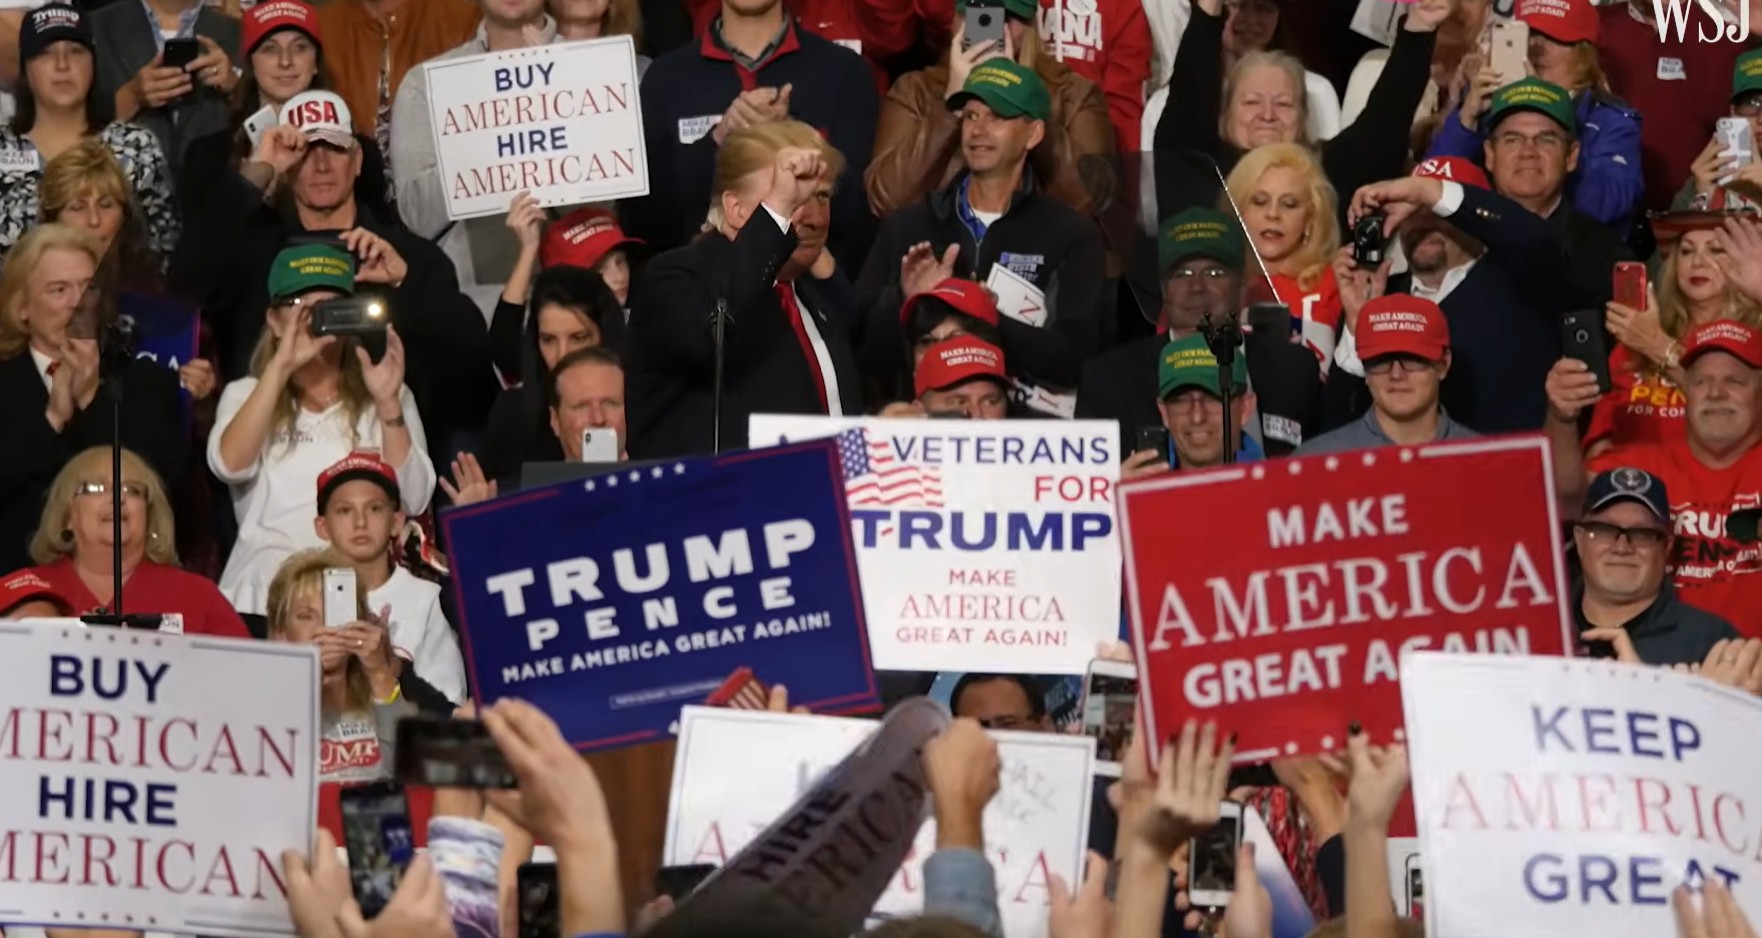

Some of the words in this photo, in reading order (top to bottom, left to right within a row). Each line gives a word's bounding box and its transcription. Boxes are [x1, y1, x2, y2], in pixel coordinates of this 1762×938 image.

[33, 9, 79, 24] Trump
[495, 62, 555, 92] BUY
[289, 100, 340, 129] USA
[442, 83, 628, 136] AMERICAN
[497, 126, 568, 157] HIRE
[453, 148, 636, 200] AMERICAN
[892, 436, 1110, 464] VETERANS
[1034, 476, 1111, 501] FOR
[851, 510, 1112, 551] TRUMP
[1267, 494, 1409, 548] MAKE
[485, 518, 816, 618] TRUMP
[949, 569, 1017, 587] MAKE
[526, 577, 795, 651] PENCE
[900, 594, 1066, 622] AMERICA
[1149, 542, 1554, 651] AMERICA
[502, 656, 564, 685] MAKE
[570, 639, 670, 672] AMERICA
[675, 625, 747, 653] GREAT
[753, 611, 832, 640] AGAIN!
[896, 627, 975, 645] GREAT
[984, 628, 1068, 646] AGAIN!
[50, 655, 170, 704] BUY
[1183, 644, 1348, 708] GREAT
[1531, 705, 1701, 762] KEEP
[38, 776, 178, 827] HIRE
[1441, 771, 1762, 862] AMERIC
[739, 791, 851, 882] HIRE
